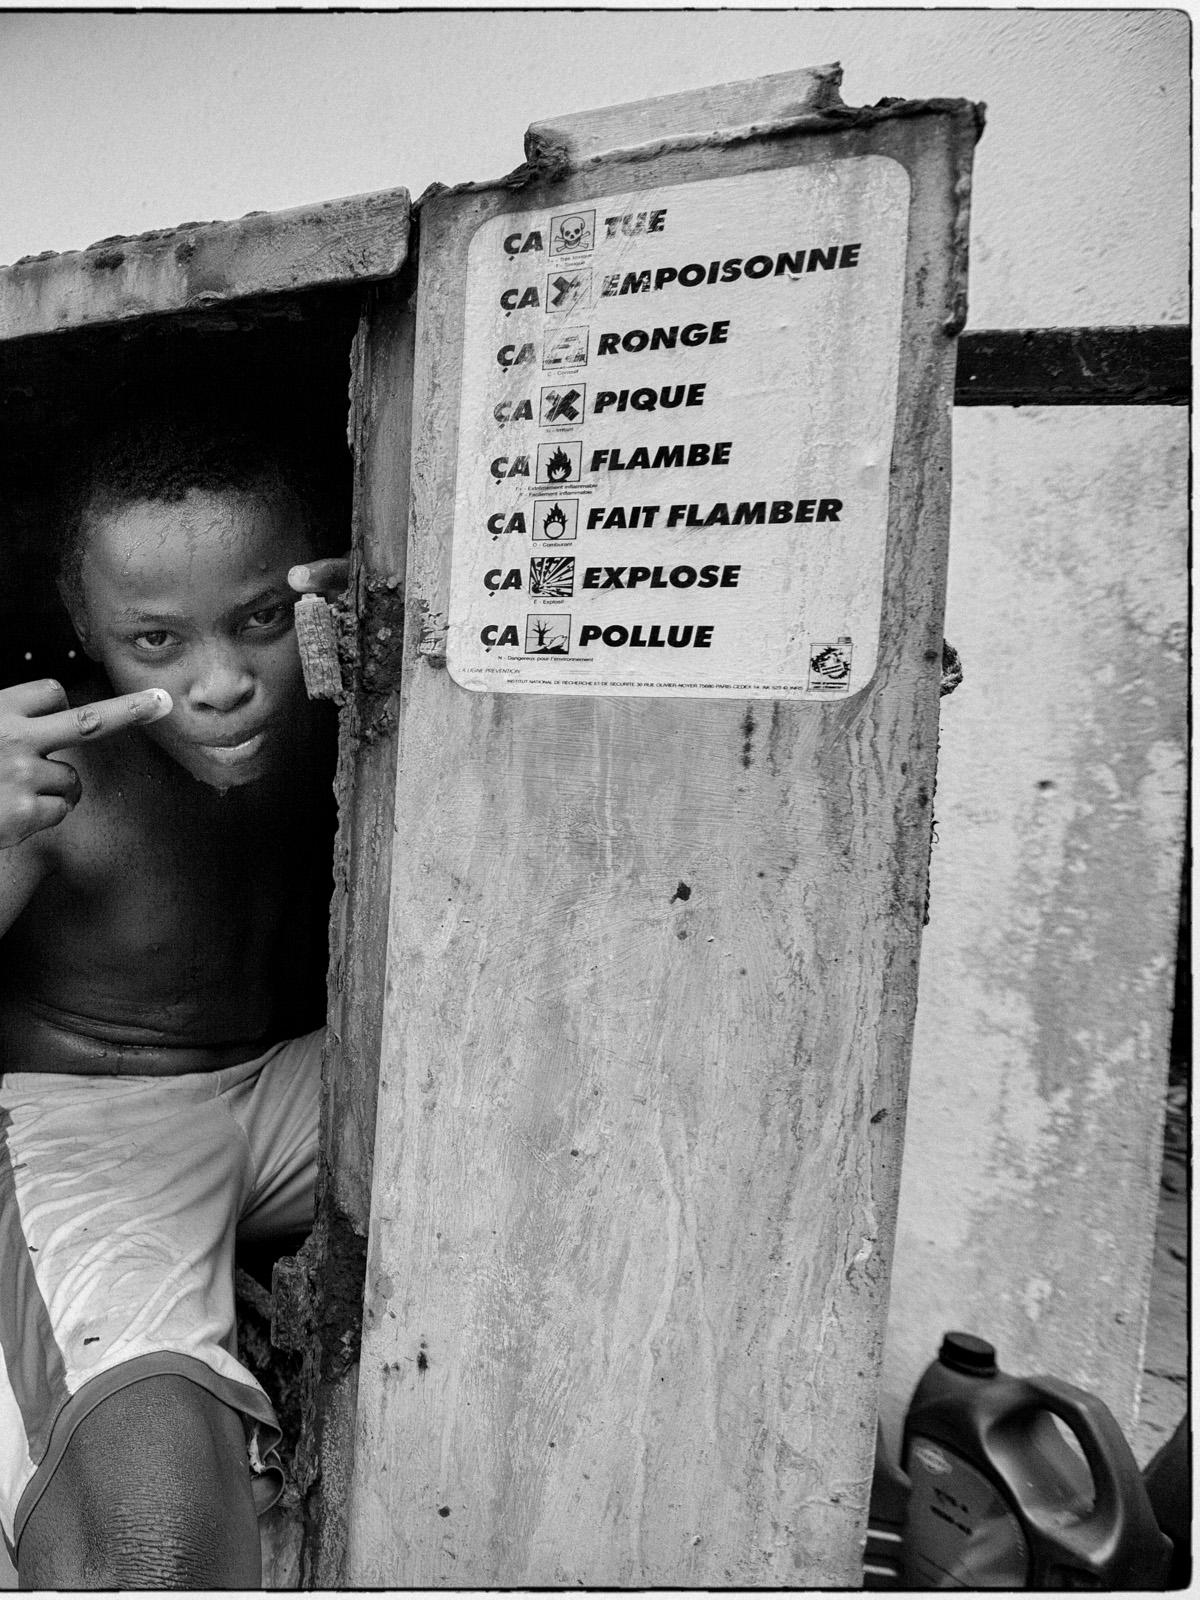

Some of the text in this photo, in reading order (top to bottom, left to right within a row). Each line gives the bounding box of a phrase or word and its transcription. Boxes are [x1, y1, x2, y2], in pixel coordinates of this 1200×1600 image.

[503, 209, 668, 261] ÇA TUE
[500, 243, 862, 318] ÇA EMPOISONNE
[496, 320, 730, 373] ÇA RONGE
[493, 383, 707, 429] ÇA PIQUE
[490, 441, 732, 485] ÇA FLAMBE
[487, 499, 844, 541] ÇA FAIT FLAMBER
[484, 565, 742, 598] ÇA EXPLOSE
[480, 625, 715, 653] ÇA POLLUE
